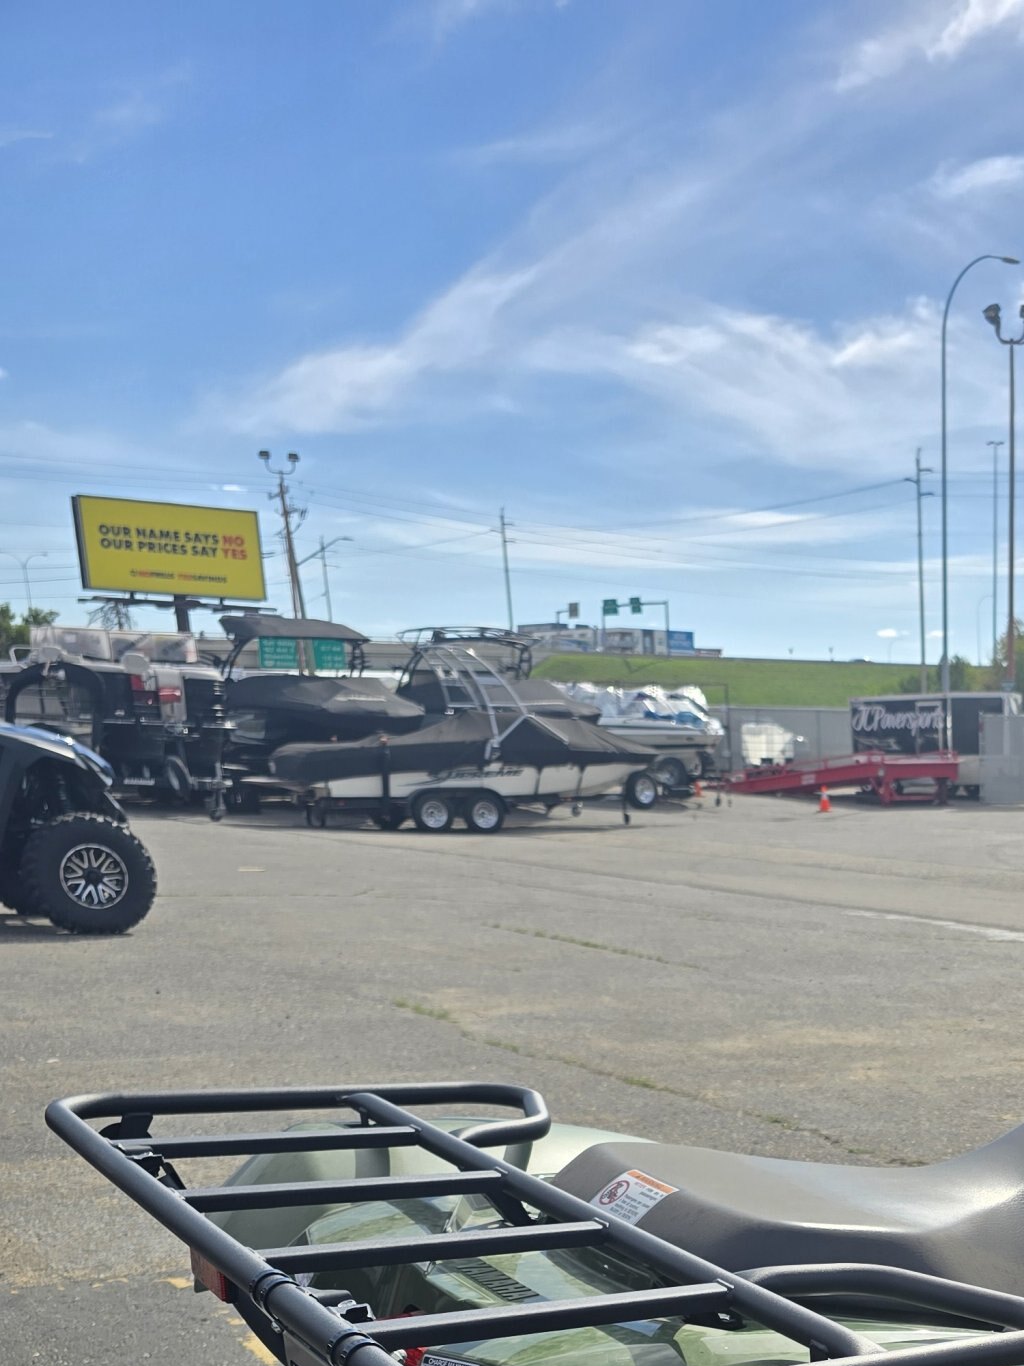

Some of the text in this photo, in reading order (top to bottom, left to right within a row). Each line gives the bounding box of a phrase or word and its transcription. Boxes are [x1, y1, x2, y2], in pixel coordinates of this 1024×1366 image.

[99, 524, 245, 547] OUR NAME SAYS NO
[100, 538, 247, 560] OUR PRICES SAY YES
[456, 1259, 540, 1301] YAMAHA
